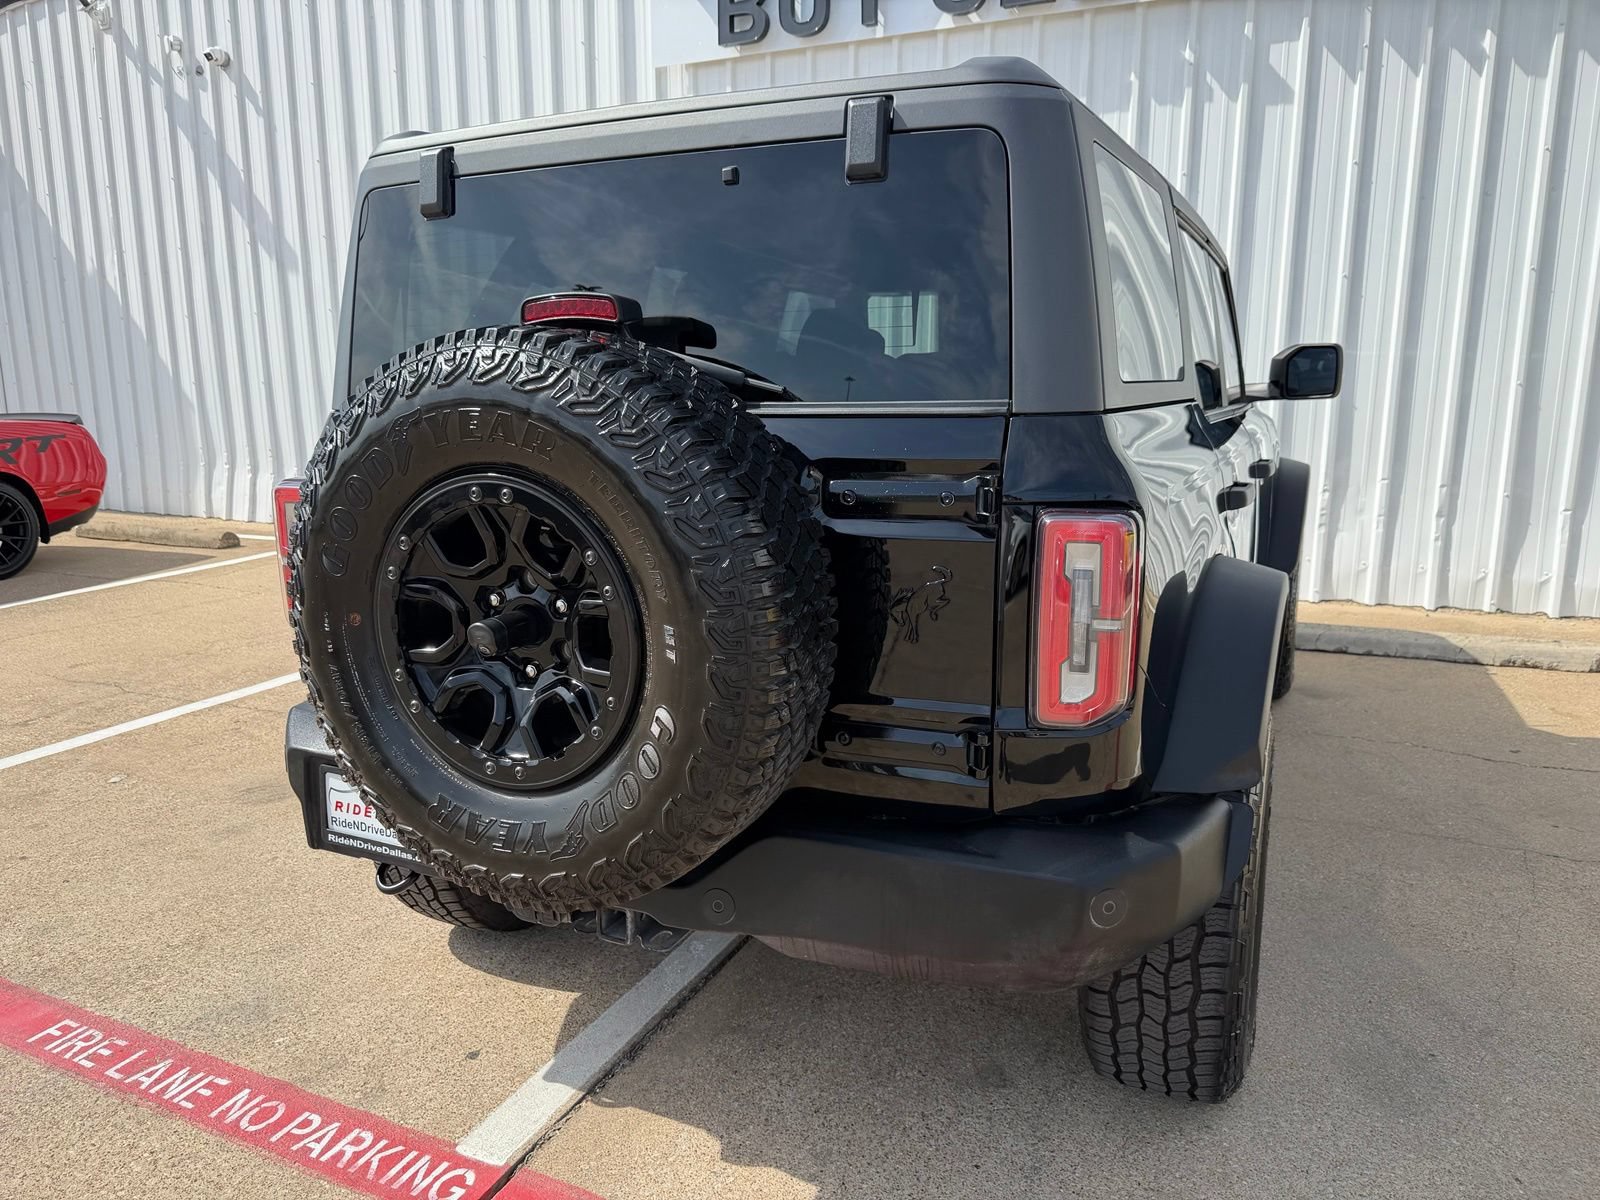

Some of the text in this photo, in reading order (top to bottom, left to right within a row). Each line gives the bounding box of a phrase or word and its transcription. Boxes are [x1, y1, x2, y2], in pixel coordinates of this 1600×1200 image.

[331, 816, 397, 838] RideNDriveDa
[328, 834, 421, 862] RideNDriveDallas.c
[26, 1019, 477, 1200] FIRE LANE NO PARKING
